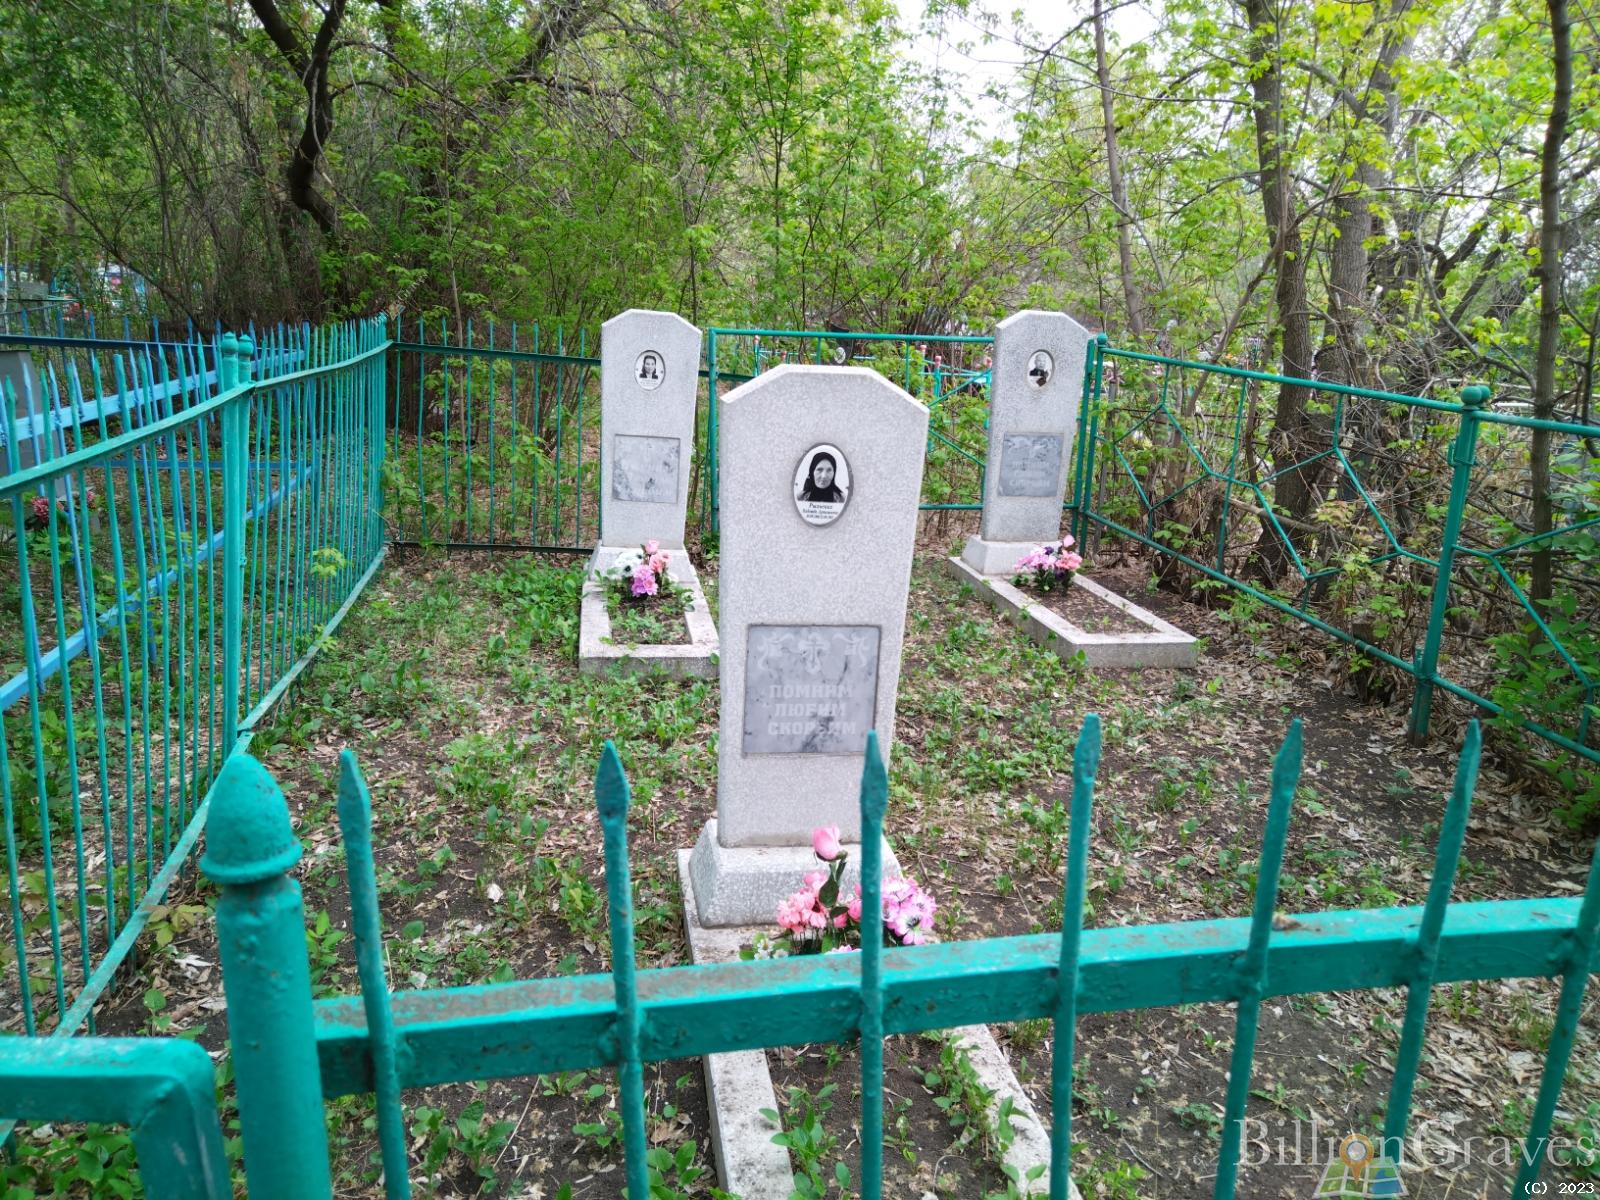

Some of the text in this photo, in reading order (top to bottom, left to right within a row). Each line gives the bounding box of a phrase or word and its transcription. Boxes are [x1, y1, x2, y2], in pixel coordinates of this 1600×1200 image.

[769, 684, 853, 698] ПОМНИМ
[774, 703, 847, 717] ЛЮБИМ
[767, 721, 857, 736] СКОРИМ
